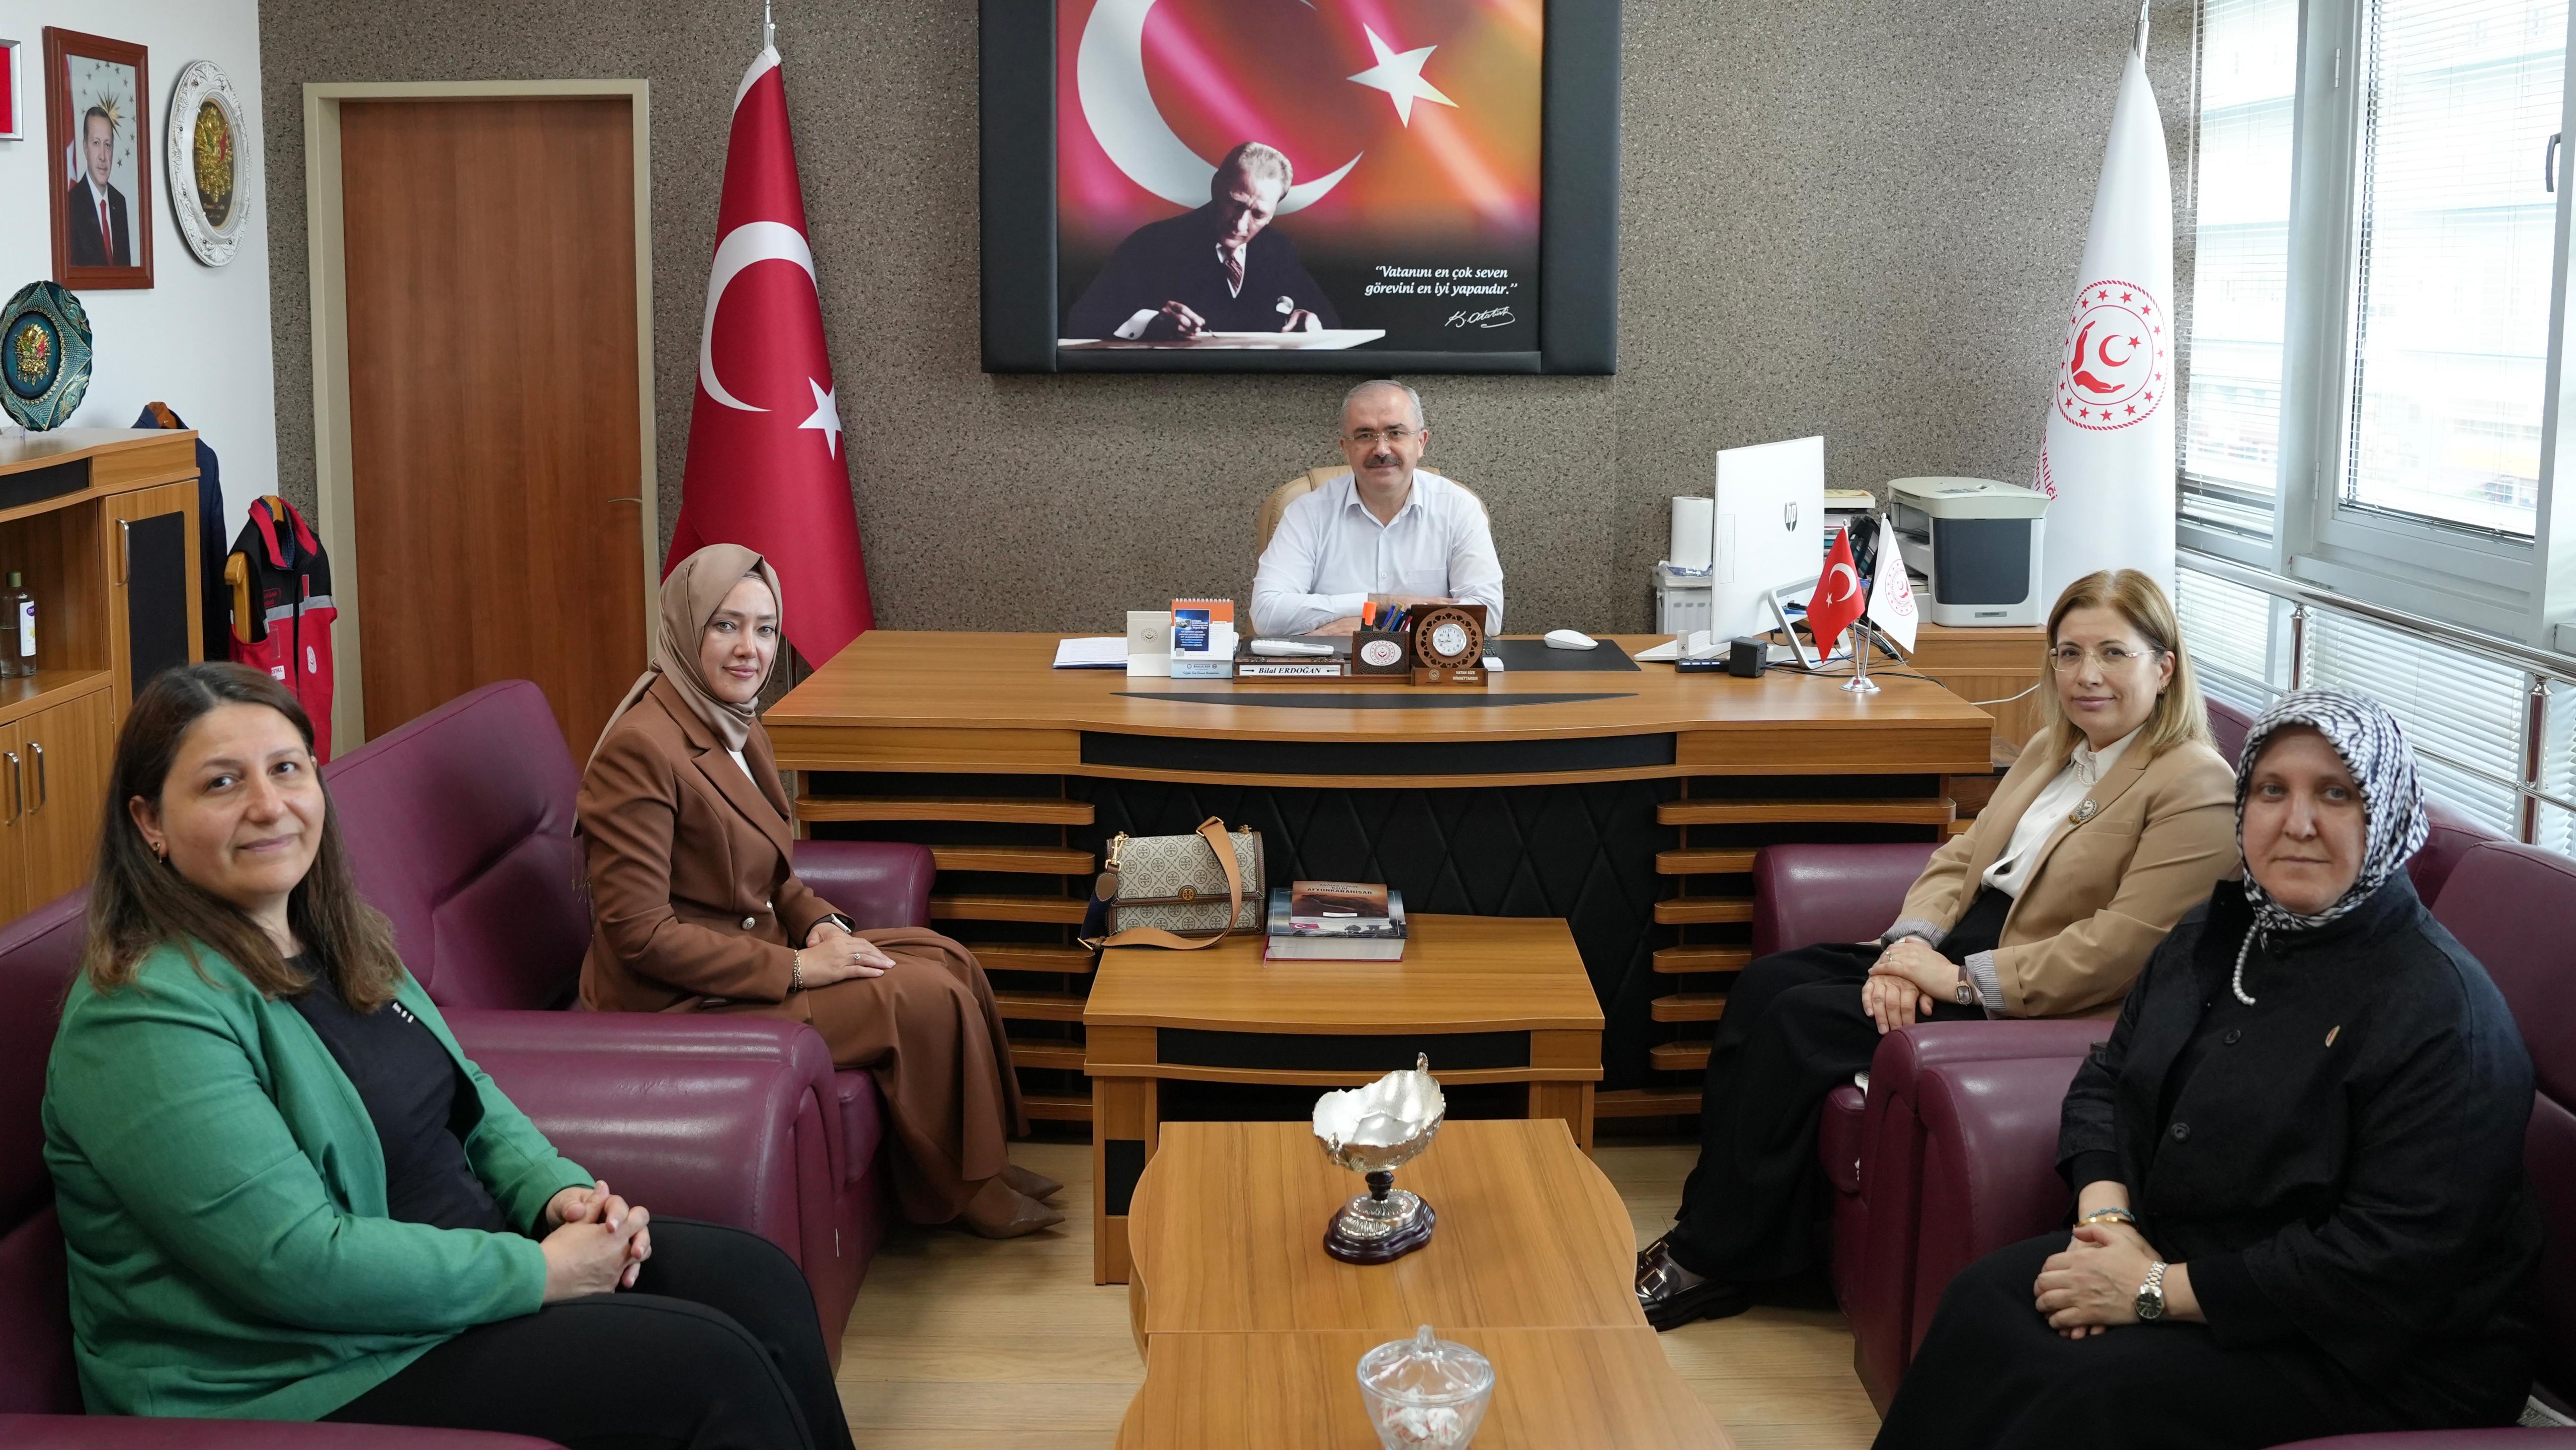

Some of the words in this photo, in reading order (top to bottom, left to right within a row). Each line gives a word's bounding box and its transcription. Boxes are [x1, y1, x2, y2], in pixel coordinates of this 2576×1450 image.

[1435, 269, 1450, 278] en
[1452, 267, 1472, 280] çok
[1475, 269, 1508, 278] seven
[1364, 282, 1415, 296] görevini
[1417, 285, 1432, 294] en
[1434, 283, 1450, 296] iyi
[1785, 502, 1797, 531] hp
